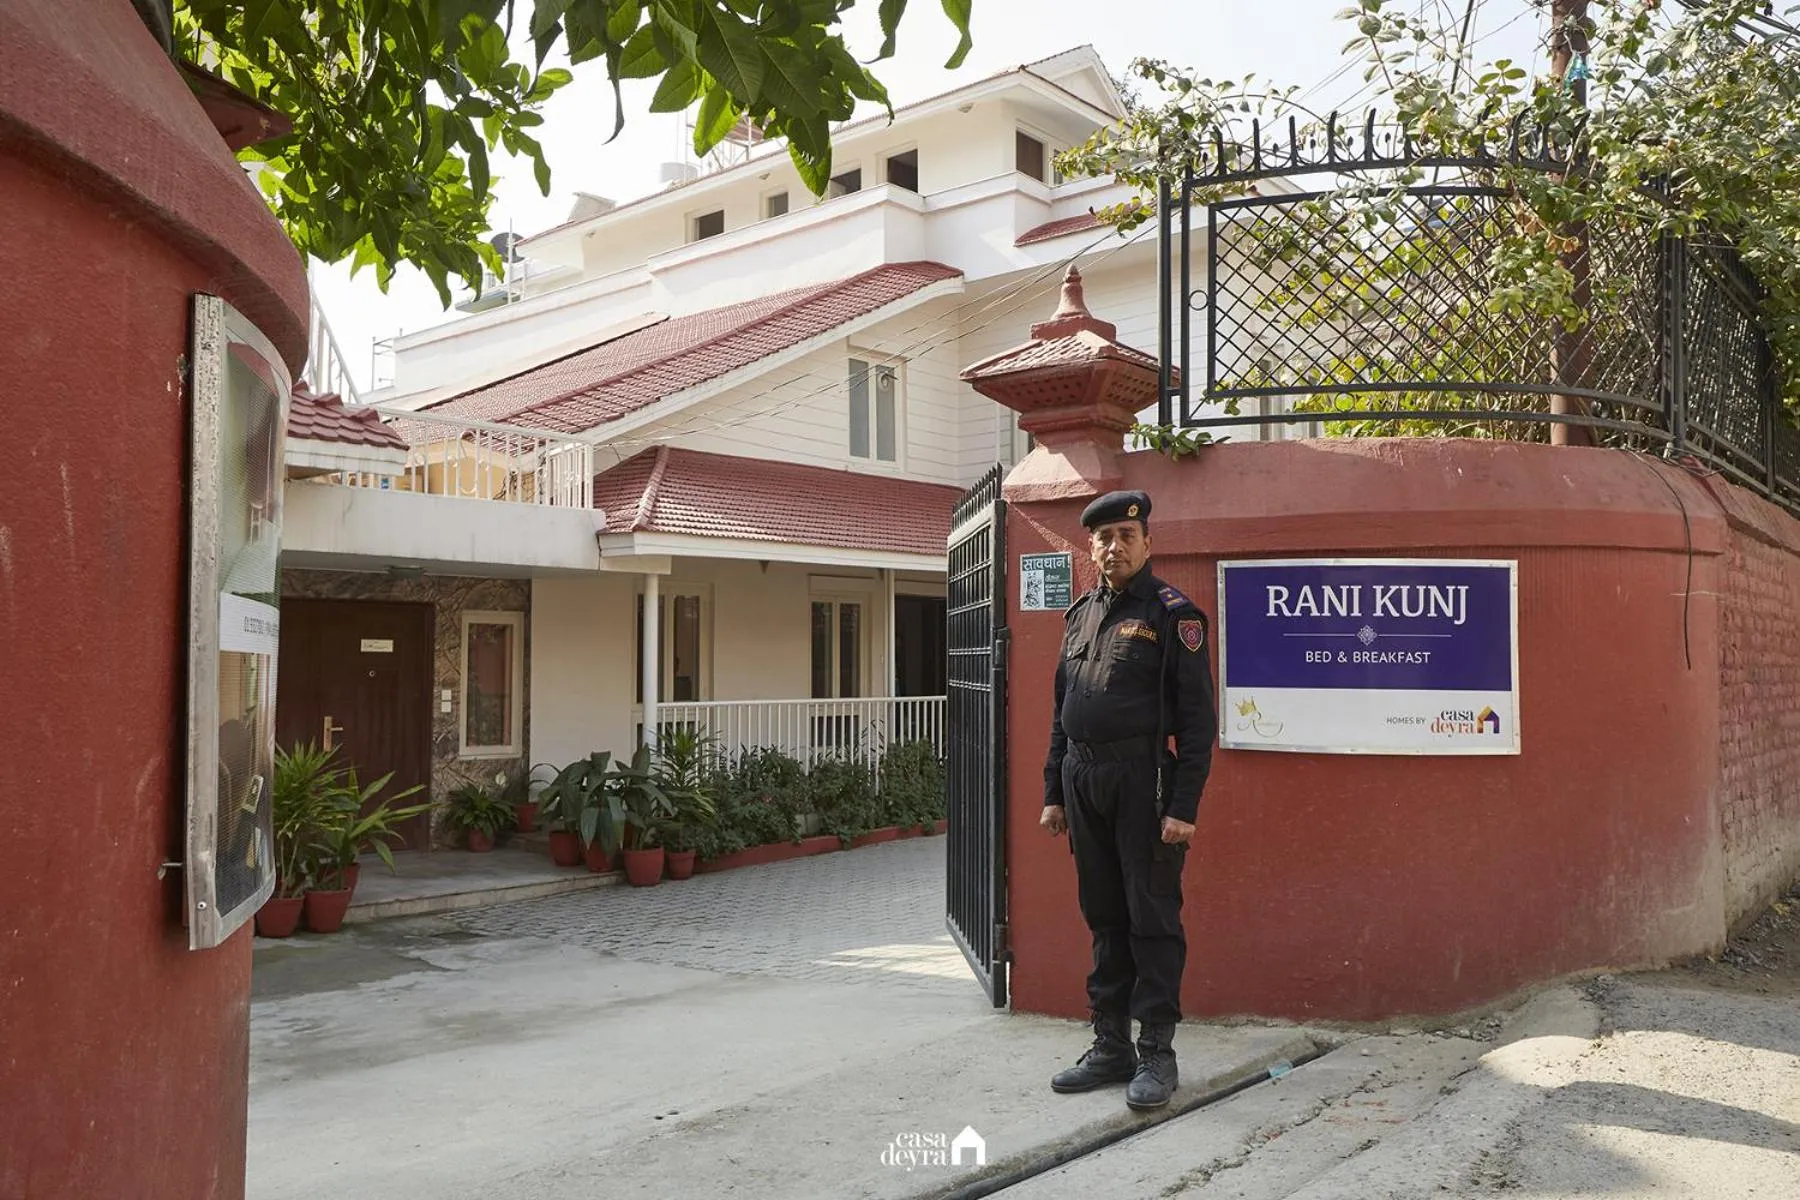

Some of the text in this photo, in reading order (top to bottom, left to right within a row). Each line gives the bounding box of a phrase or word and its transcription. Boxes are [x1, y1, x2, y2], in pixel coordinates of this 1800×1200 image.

[1266, 585, 1469, 625] RANI KUNJ
[1305, 651, 1431, 664] BED & BREAKFAST
[1386, 716, 1426, 725] HOMES BY
[1440, 709, 1474, 721] casa
[1430, 717, 1475, 738] deyra
